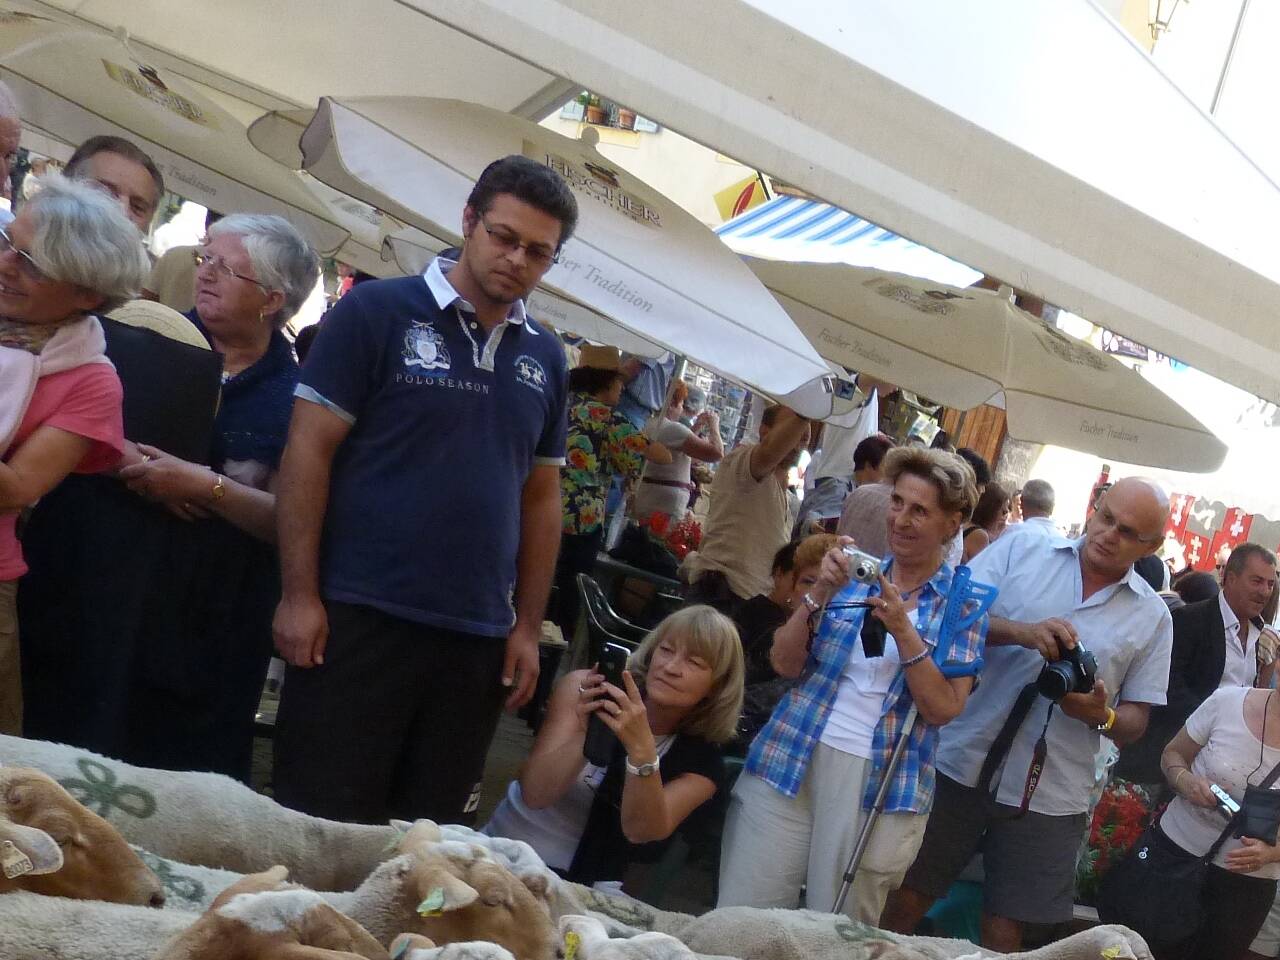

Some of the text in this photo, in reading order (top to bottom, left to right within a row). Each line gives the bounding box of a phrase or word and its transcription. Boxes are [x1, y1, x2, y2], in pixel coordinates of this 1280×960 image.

[584, 263, 654, 313] Tradition
[396, 373, 489, 395] POLO SEASON
